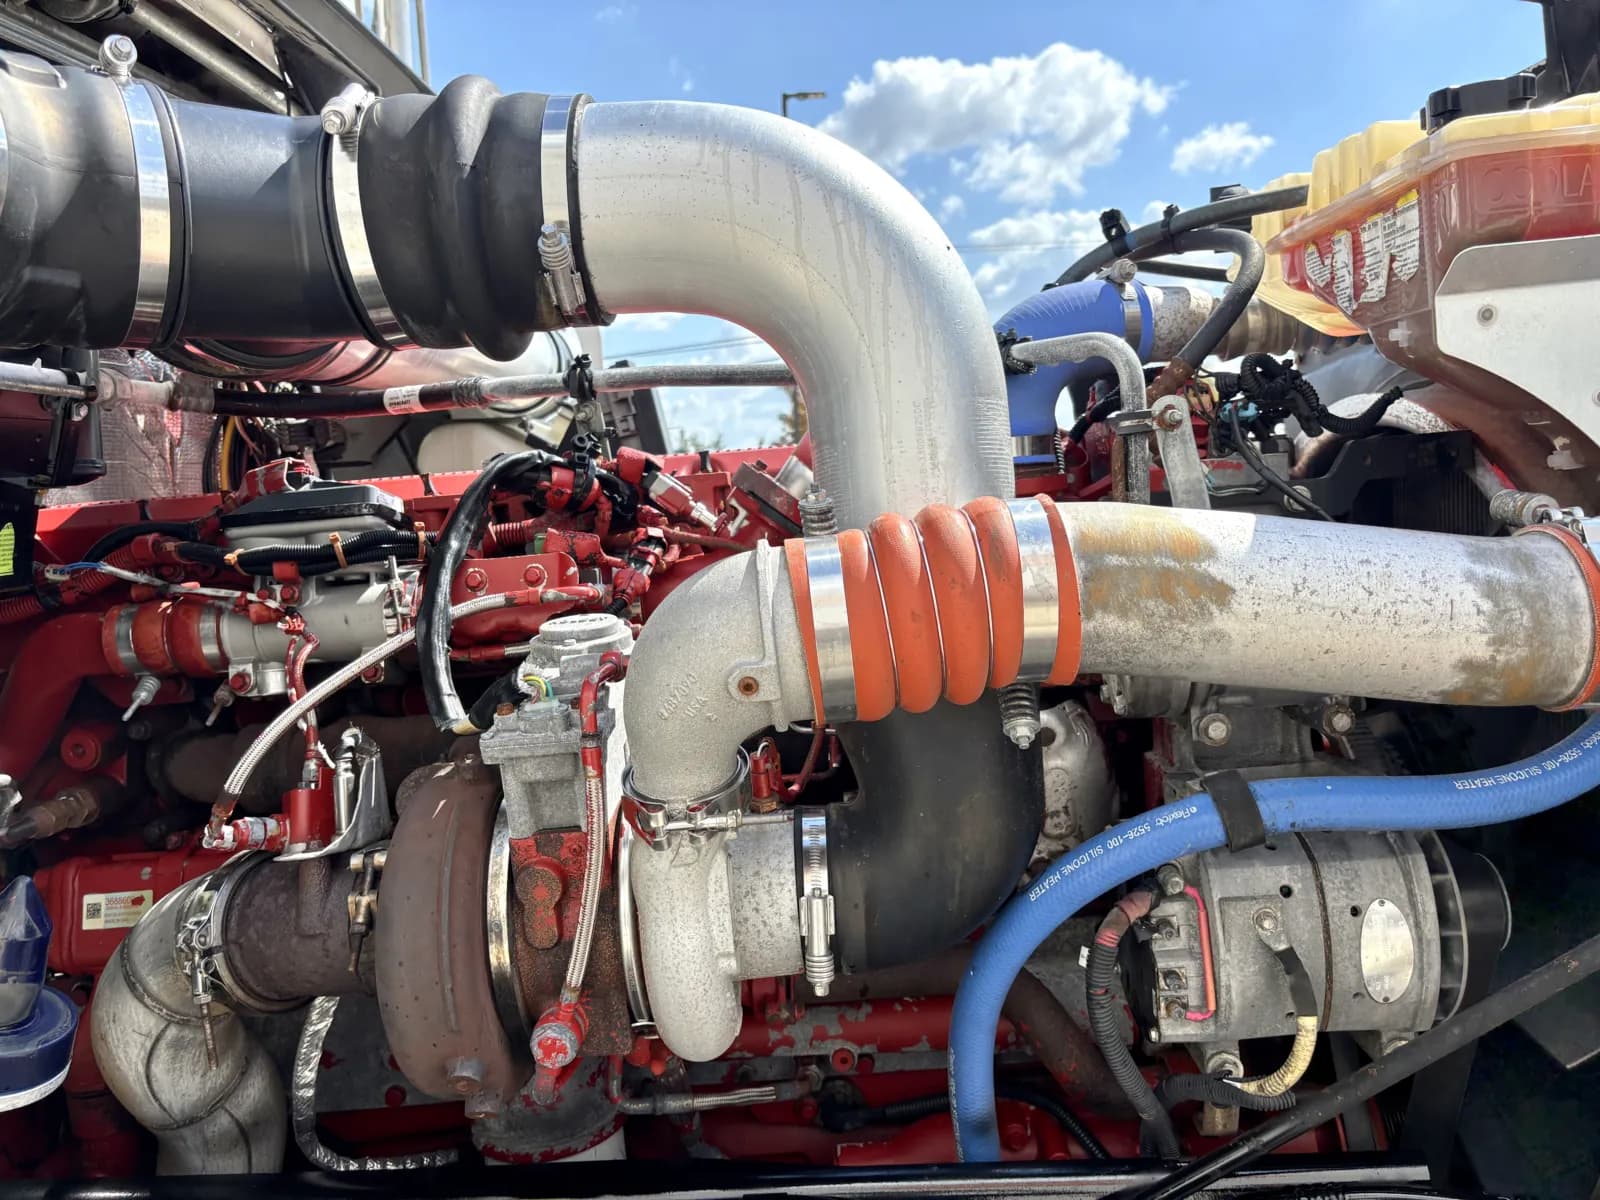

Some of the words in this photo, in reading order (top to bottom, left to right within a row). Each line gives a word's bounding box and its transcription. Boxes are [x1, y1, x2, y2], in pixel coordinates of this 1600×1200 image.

[1453, 776, 1496, 790] HEATER
[1496, 765, 1542, 784] SILICONE
[1060, 844, 1104, 874] SILICONE
[1029, 875, 1062, 902] HEATER
